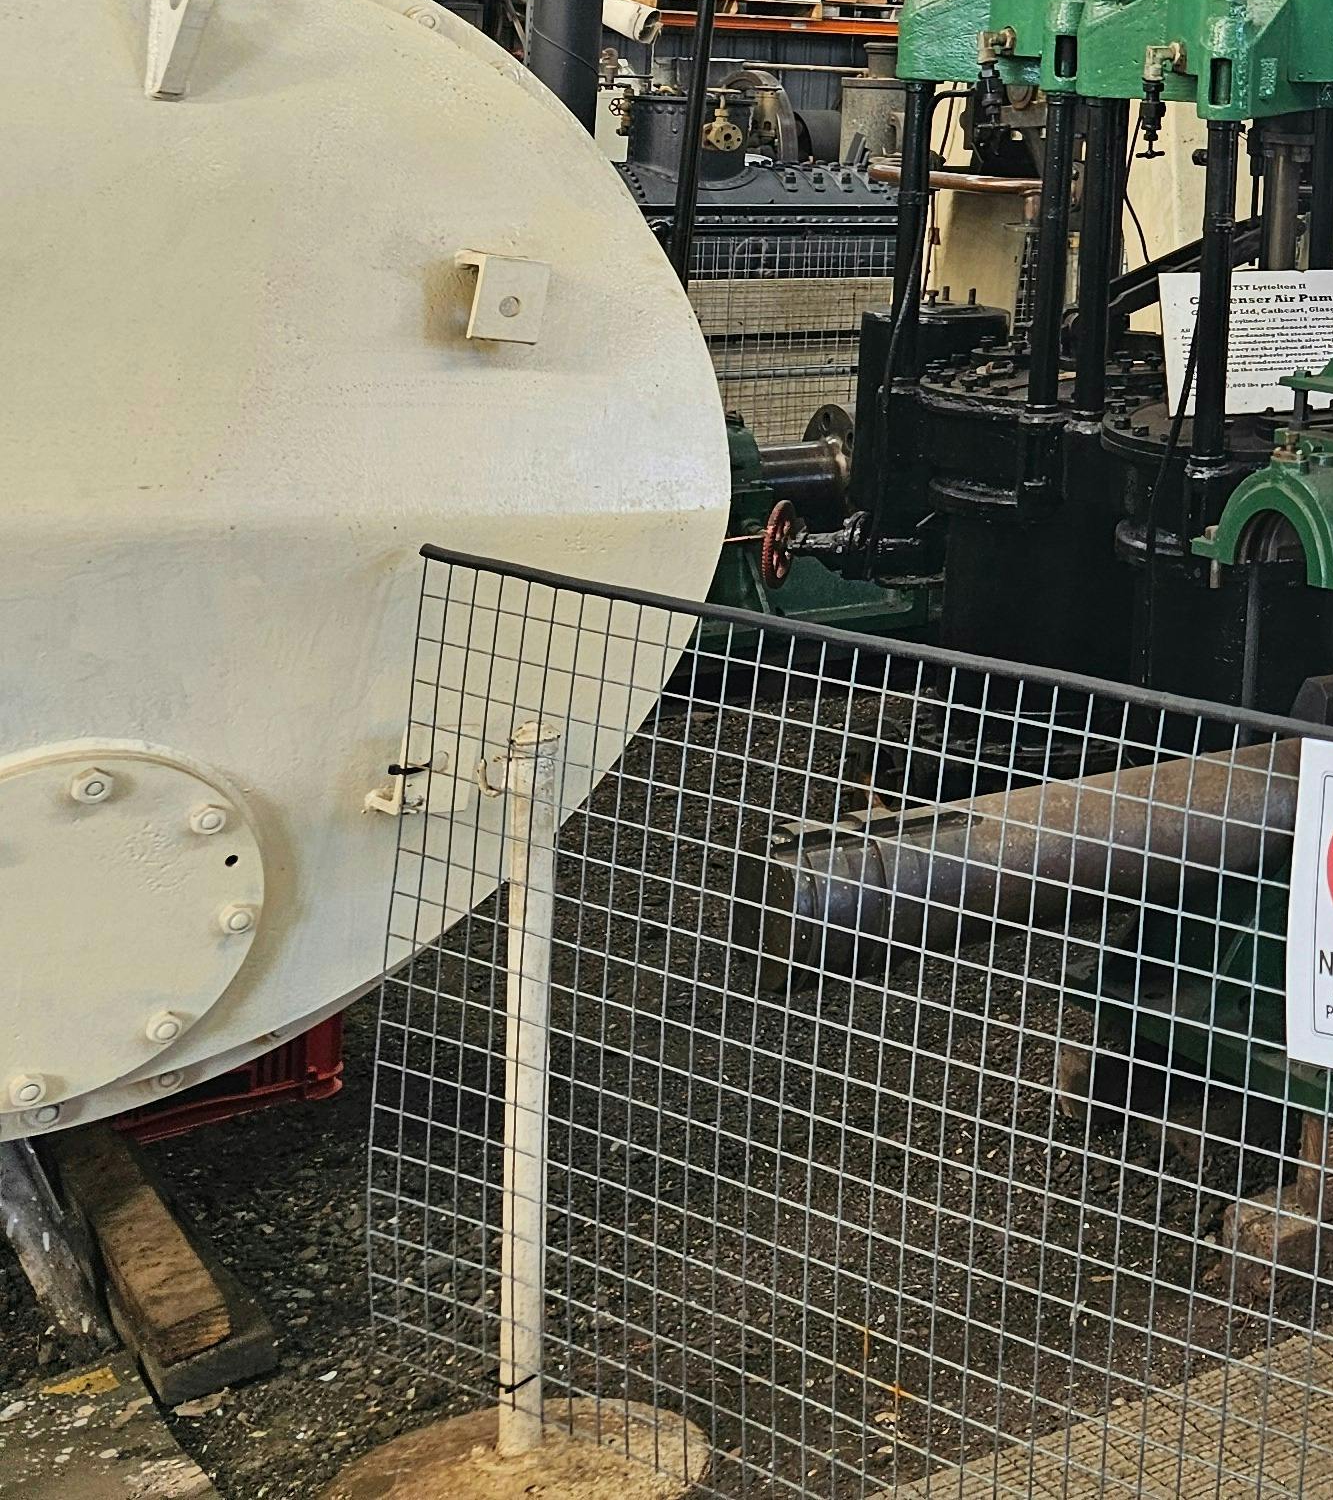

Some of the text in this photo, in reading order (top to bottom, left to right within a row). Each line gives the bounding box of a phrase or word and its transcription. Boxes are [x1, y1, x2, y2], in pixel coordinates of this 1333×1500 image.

[1189, 294, 1270, 305] Censer
[1274, 294, 1296, 303] Air
[1261, 305, 1308, 315] Cathcart,
